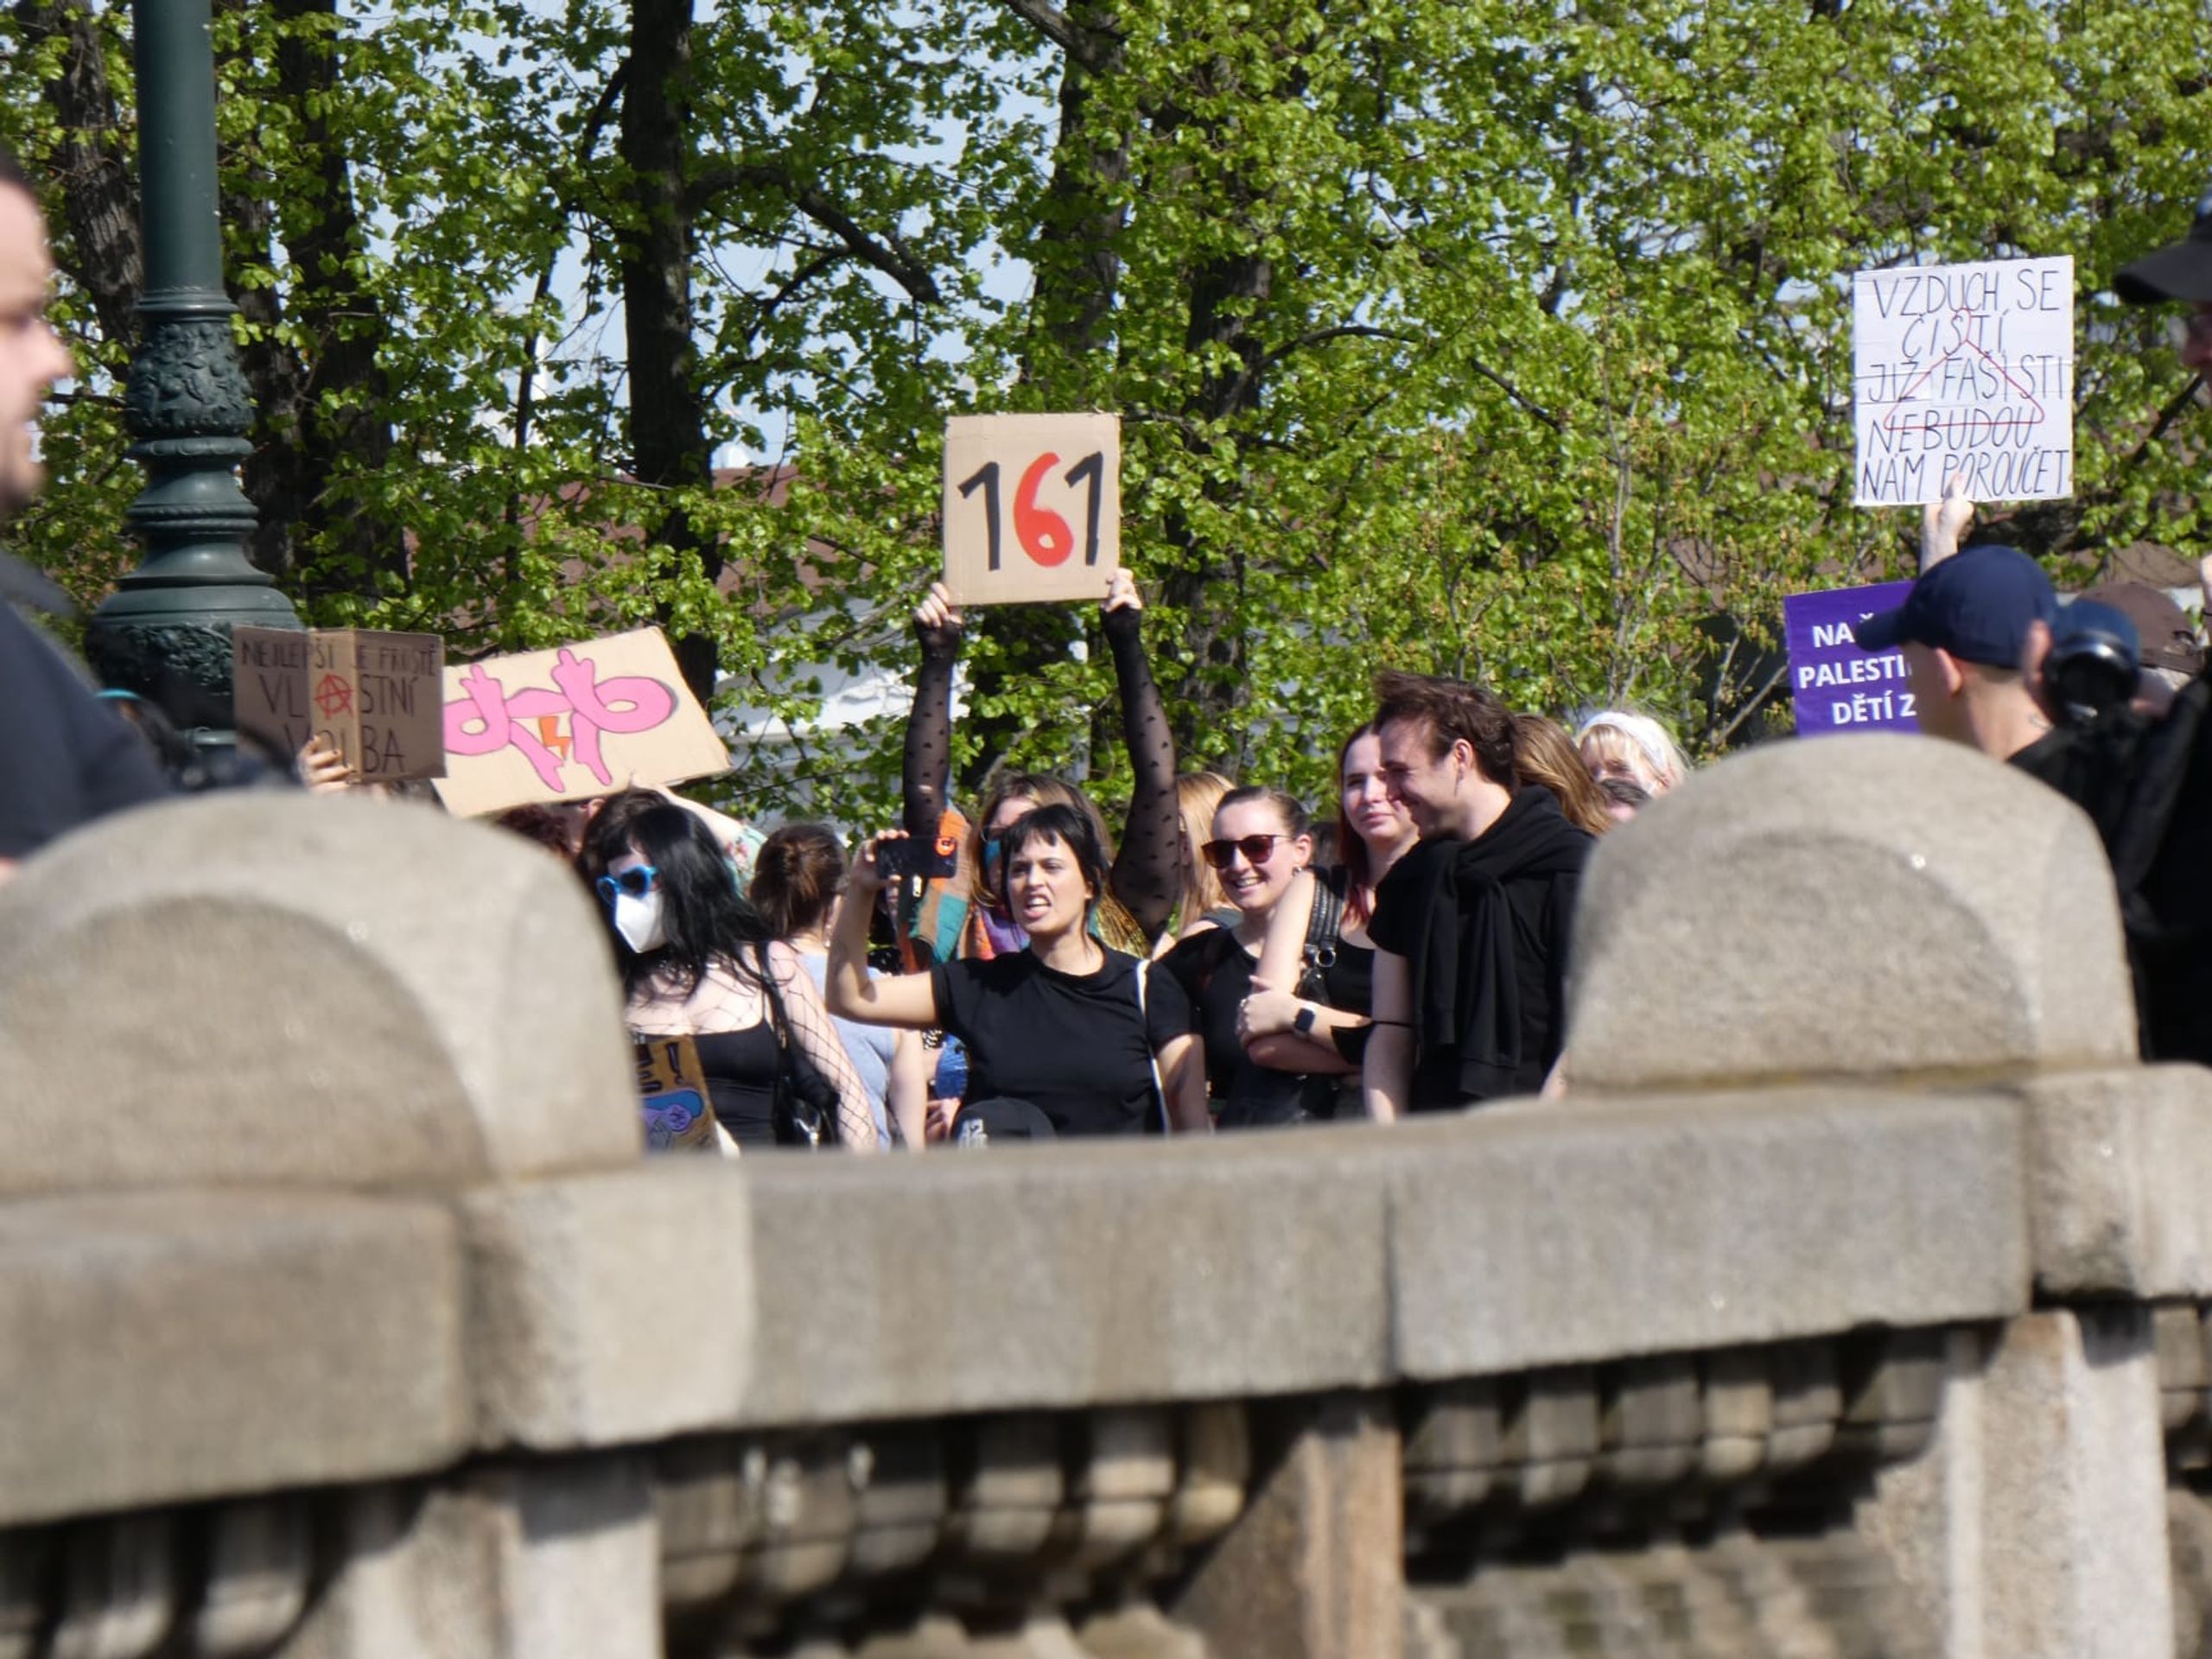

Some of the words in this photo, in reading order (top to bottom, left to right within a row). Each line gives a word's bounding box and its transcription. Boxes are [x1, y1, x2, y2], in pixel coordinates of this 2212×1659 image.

[1872, 270, 2000, 319] VZDUCH
[2016, 268, 2060, 311] SE
[1902, 310, 2009, 359] ČISTÍ
[1867, 406, 2036, 458] NEBUDOU
[1862, 454, 1925, 502] NÁM
[1940, 446, 2069, 499] POROUČET
[957, 450, 1103, 572] 161
[1812, 622, 1855, 648] NA
[1798, 654, 1912, 689] PALESTI
[1832, 690, 1894, 725] DĚTÍ
